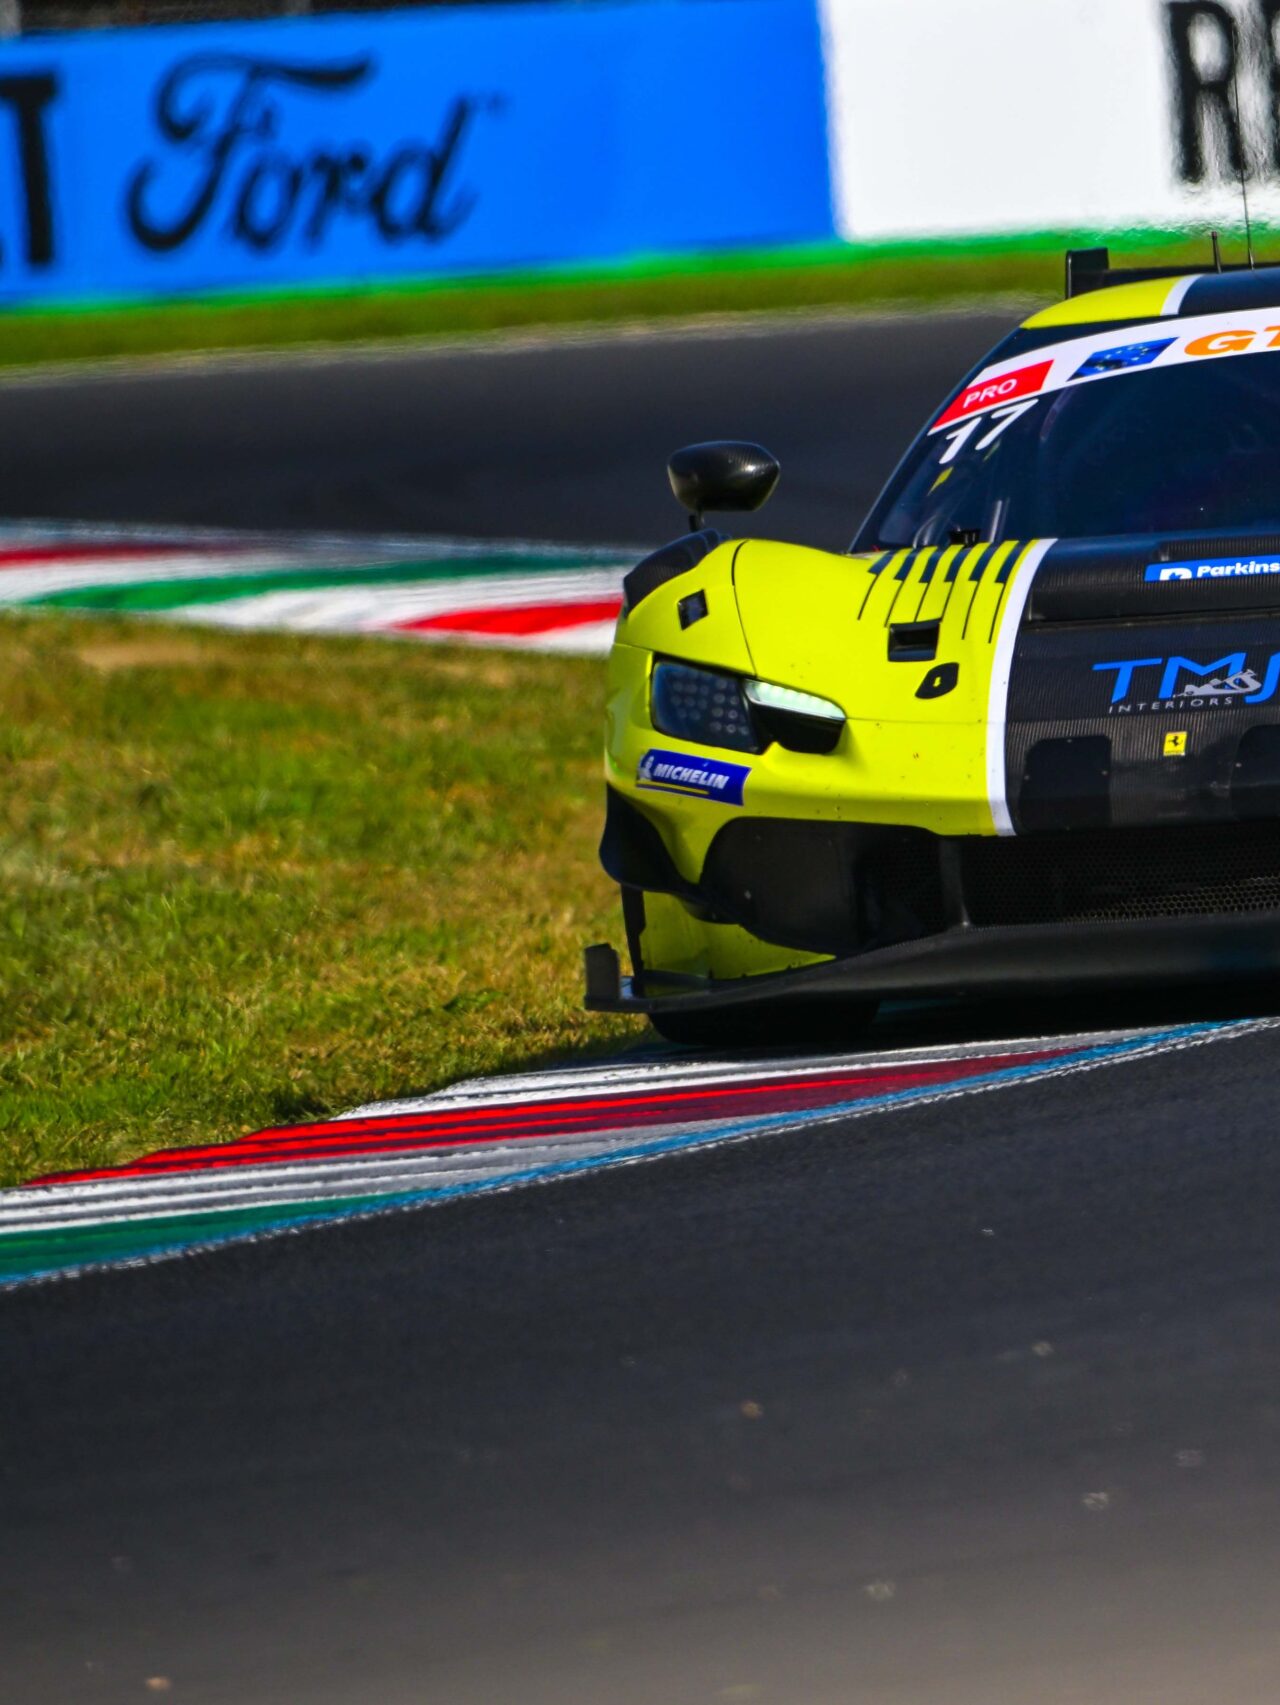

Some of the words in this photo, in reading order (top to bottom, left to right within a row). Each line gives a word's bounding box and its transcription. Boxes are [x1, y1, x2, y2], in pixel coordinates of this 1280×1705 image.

[126, 52, 478, 252] Ford
[963, 378, 1018, 409] PRO
[939, 398, 1039, 465] 17
[1108, 696, 1234, 714] INTERIORS
[653, 762, 730, 789] MICHELIN
